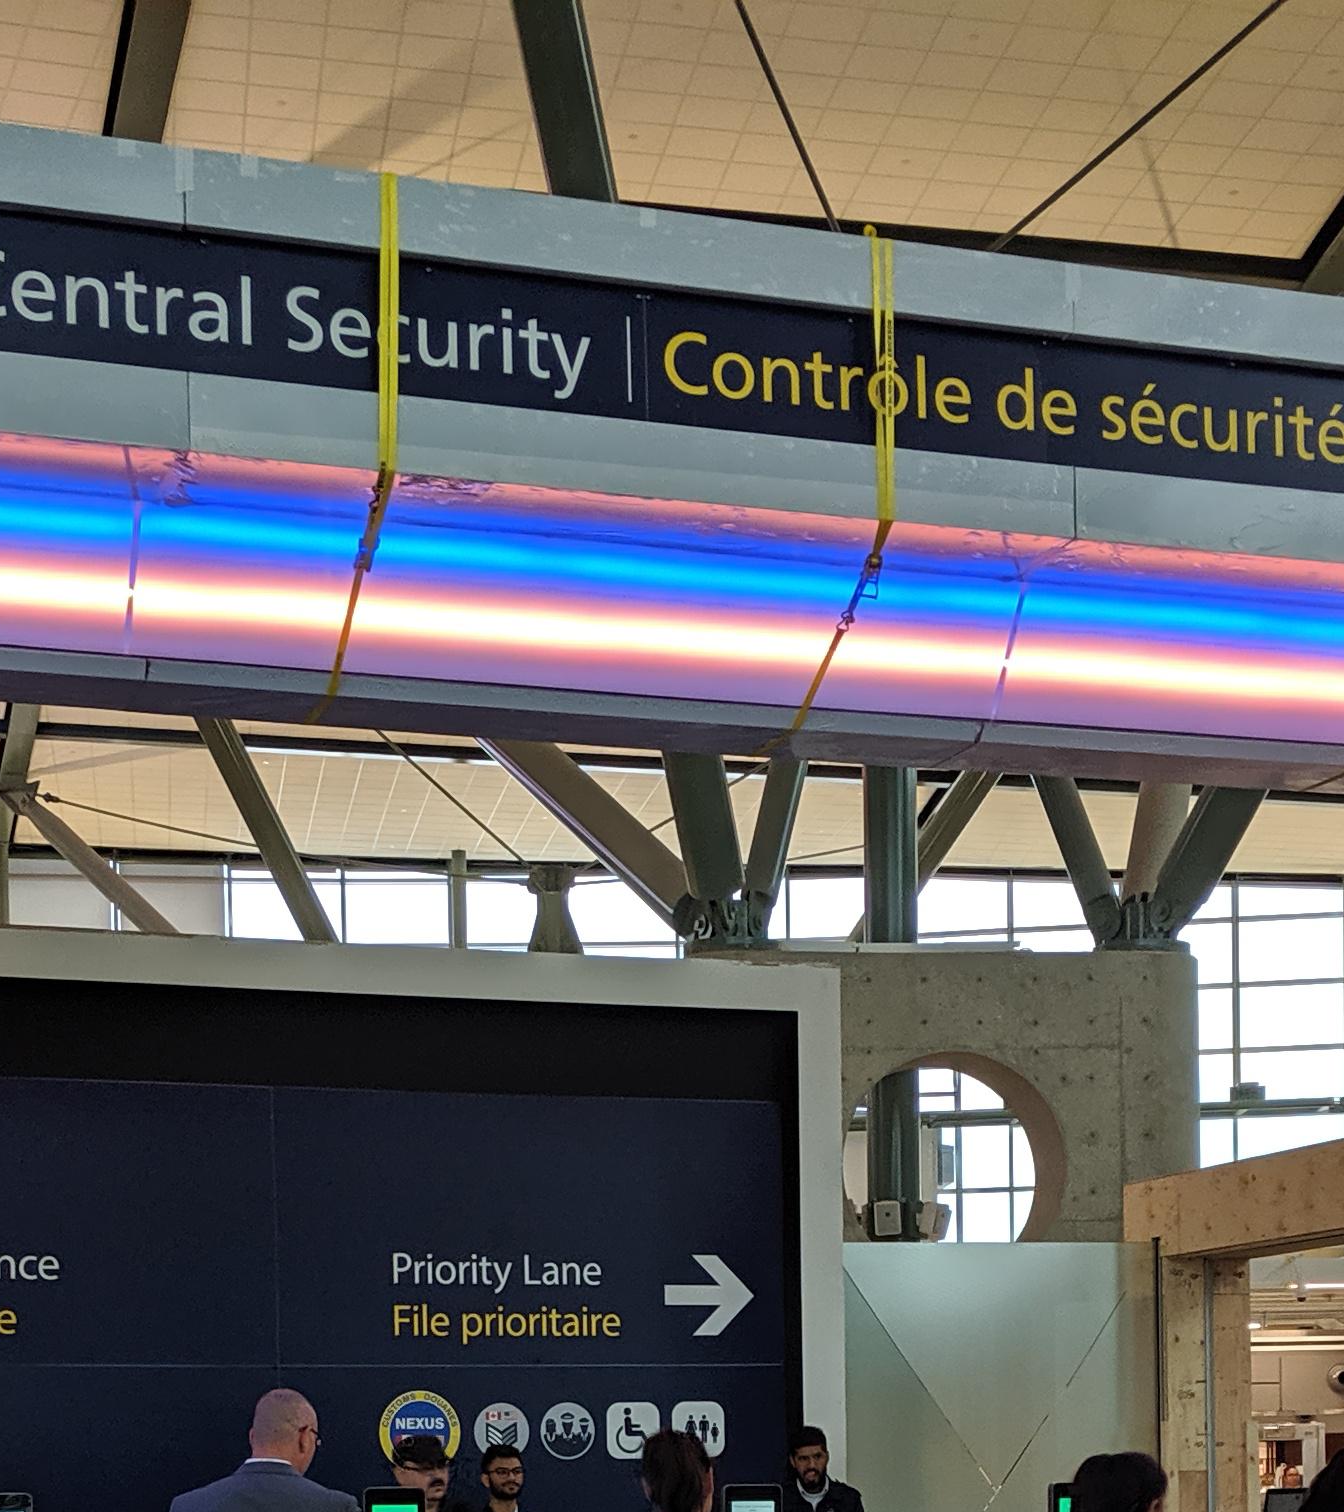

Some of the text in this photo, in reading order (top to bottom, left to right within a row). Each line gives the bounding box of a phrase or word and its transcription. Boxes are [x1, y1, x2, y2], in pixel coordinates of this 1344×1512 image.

[663, 331, 970, 424] Contrôle
[997, 368, 1077, 436] de
[392, 1252, 602, 1294] Priority Lane
[393, 1303, 621, 1345] File prioritaire
[382, 1392, 458, 1427] CUSTOMS DOUANES
[395, 1416, 445, 1430] NEXUS
